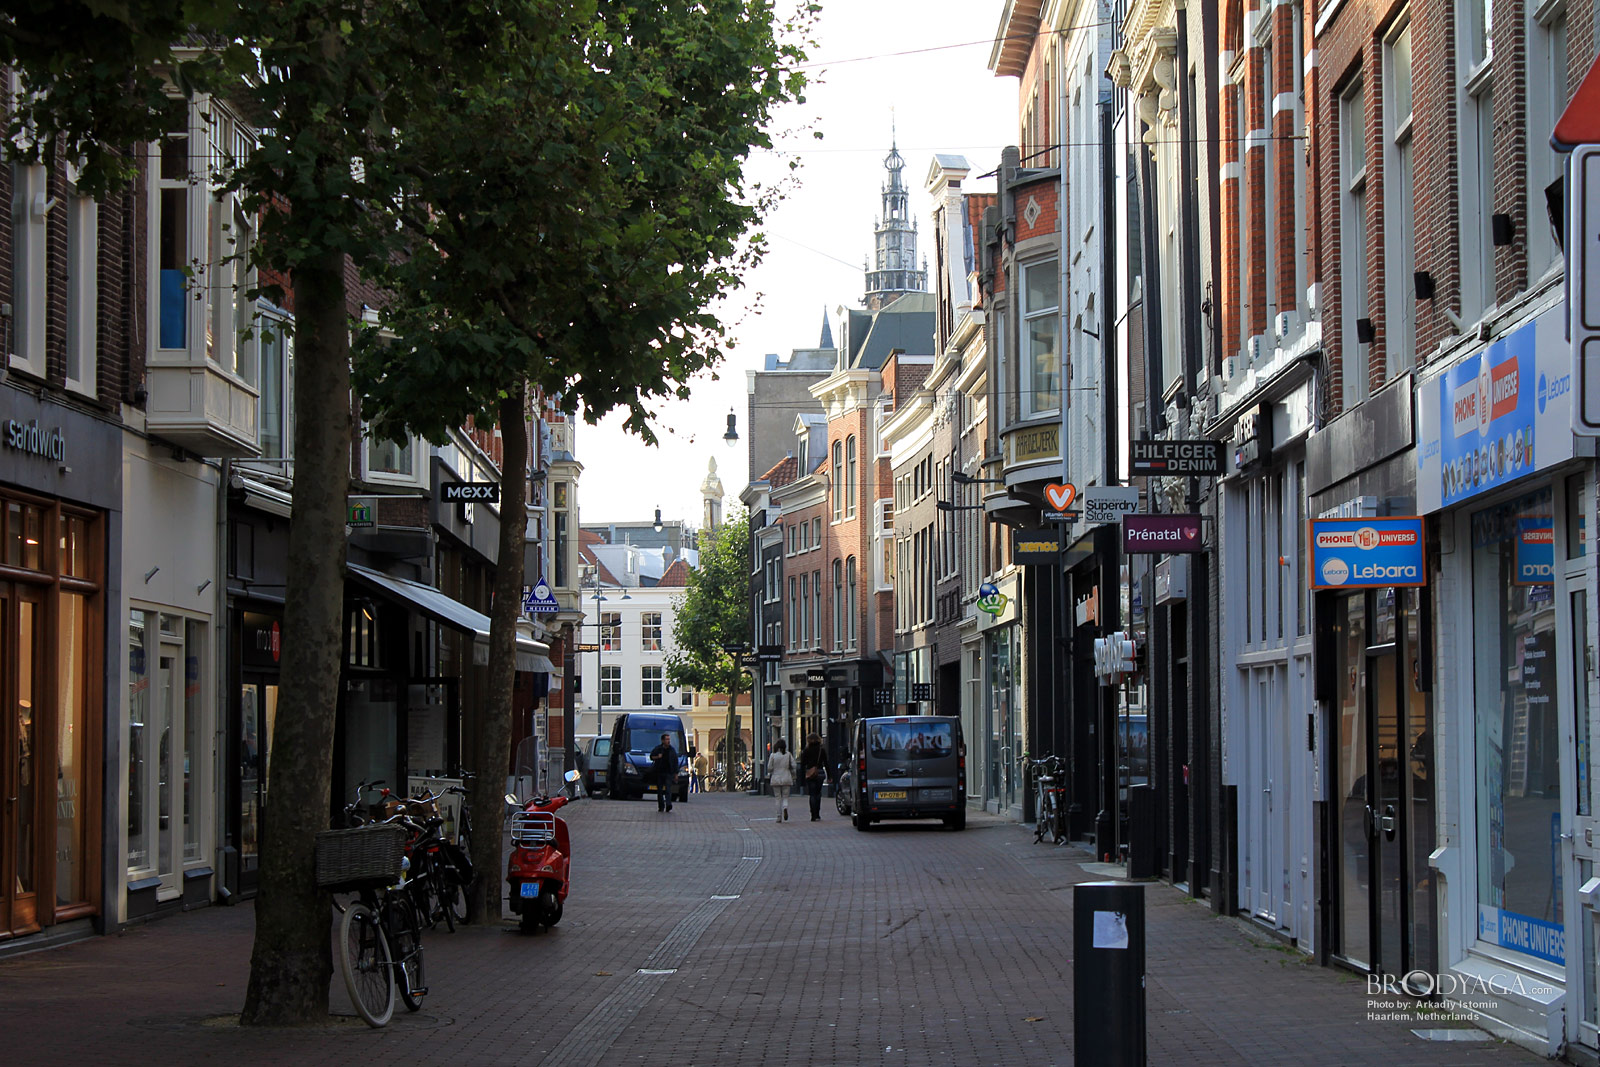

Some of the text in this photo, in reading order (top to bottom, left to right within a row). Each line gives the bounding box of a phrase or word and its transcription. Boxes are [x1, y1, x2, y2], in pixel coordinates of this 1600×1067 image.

[1454, 369, 1518, 424] PHONE UNIVERSE
[9, 419, 65, 461] sandwich
[1134, 444, 1216, 458] HILFIGER
[1168, 459, 1217, 471] DENIM
[1086, 499, 1138, 513] Superdry
[1086, 510, 1116, 521] Store.
[1128, 527, 1181, 541] Prénatal
[1319, 533, 1416, 544] PHONE UNIVERSE
[1018, 541, 1059, 553] xenos
[1324, 563, 1417, 579] Lebara Lebara
[1502, 915, 1529, 948] PHONE
